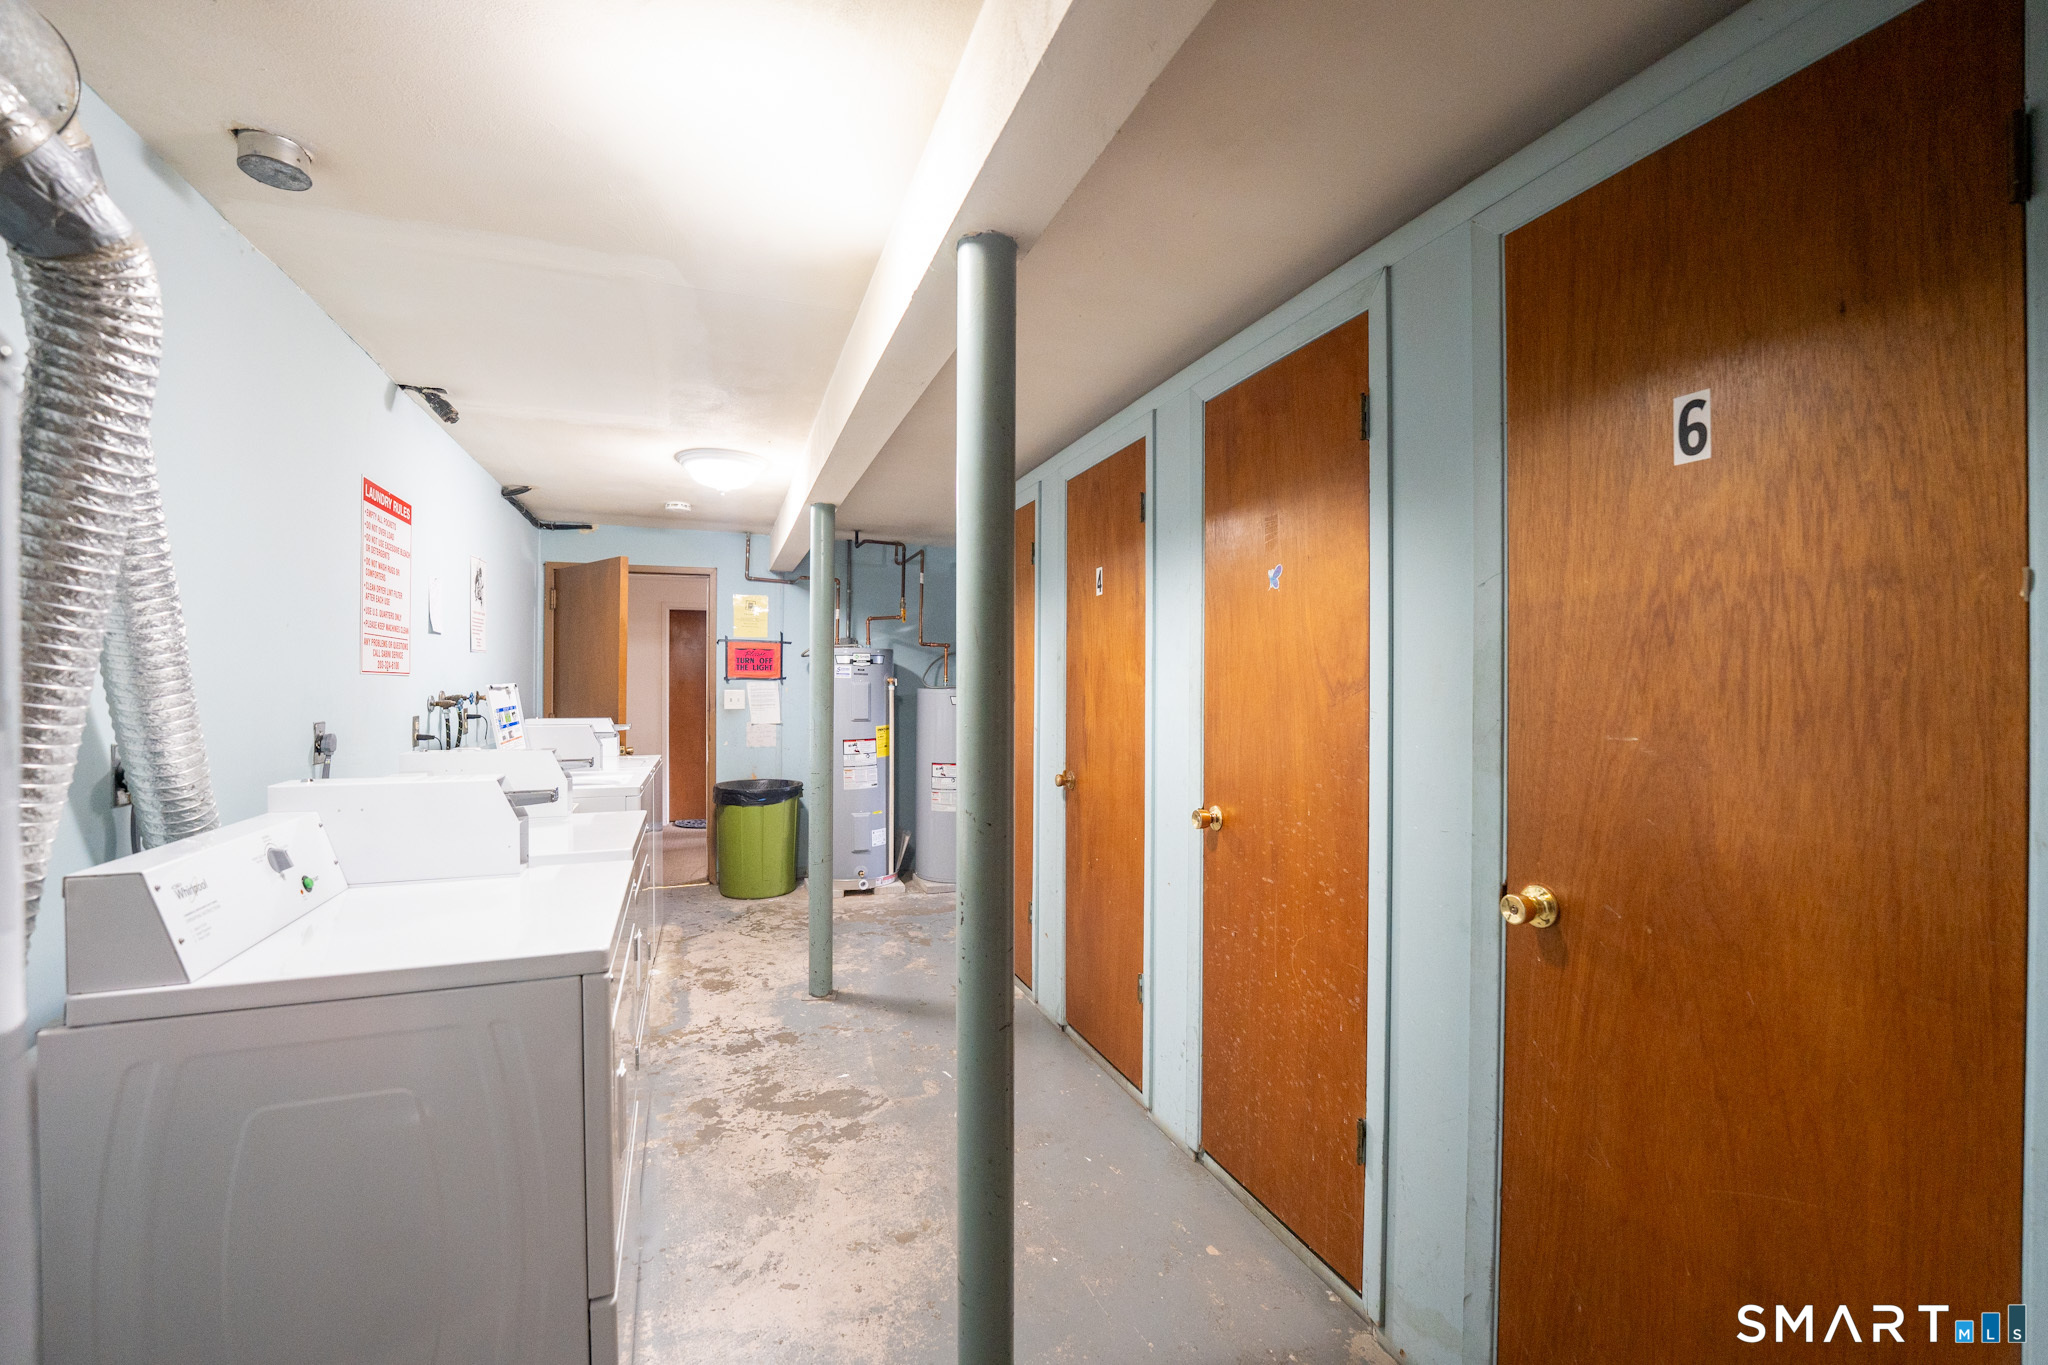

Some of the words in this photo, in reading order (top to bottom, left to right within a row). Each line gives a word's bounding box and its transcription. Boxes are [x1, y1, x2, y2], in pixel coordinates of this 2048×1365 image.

[1678, 398, 1707, 457] 6
[366, 484, 392, 510] LAUNDRY
[393, 500, 410, 520] RULES
[1096, 569, 1102, 593] 4
[365, 592, 375, 602] AFTER
[366, 582, 375, 592] CLEAN
[376, 585, 386, 595] DRYER
[394, 590, 402, 600] FILTER
[380, 610, 394, 620] QUARTERS
[366, 620, 377, 629] PLEASE
[386, 624, 400, 633] MACHINES
[371, 639, 388, 648] PROBLEMS
[174, 878, 208, 900] Whirlpool
